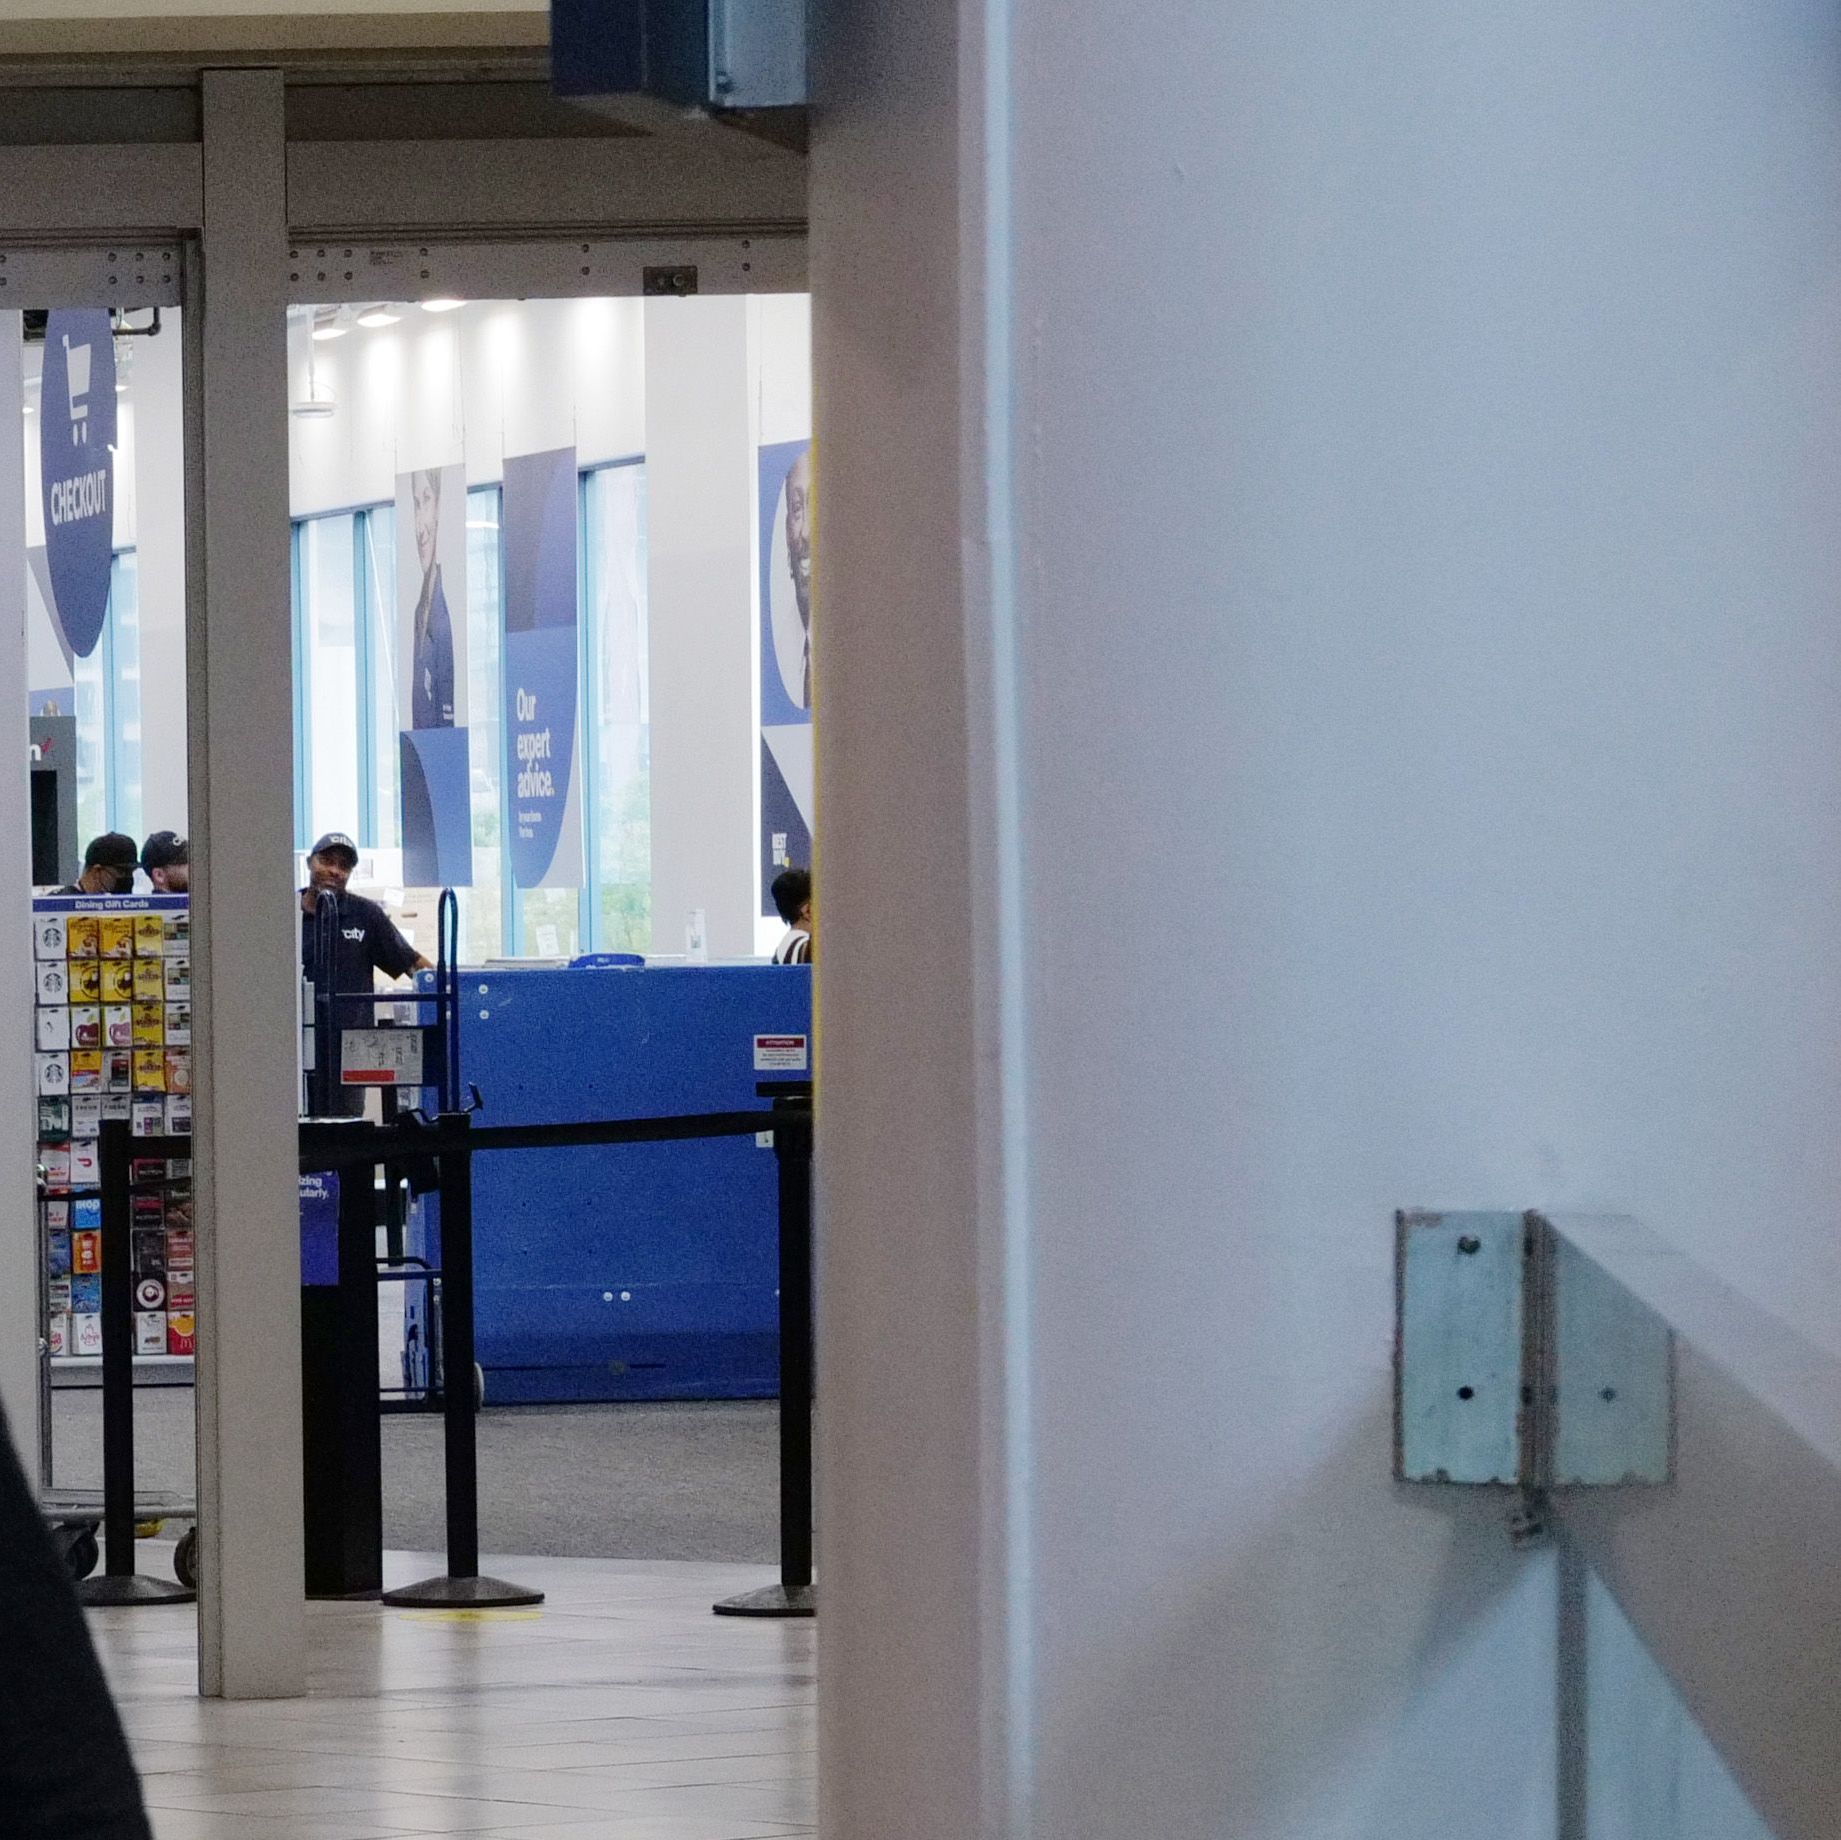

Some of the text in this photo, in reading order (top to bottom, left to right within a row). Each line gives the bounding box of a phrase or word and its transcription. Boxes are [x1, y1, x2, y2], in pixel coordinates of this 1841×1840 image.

[50, 469, 107, 526] CHECKOUT
[517, 687, 537, 722] Our
[518, 728, 551, 768] expert
[518, 761, 555, 799] advice.
[74, 899, 150, 910] Dining Gift Cards
